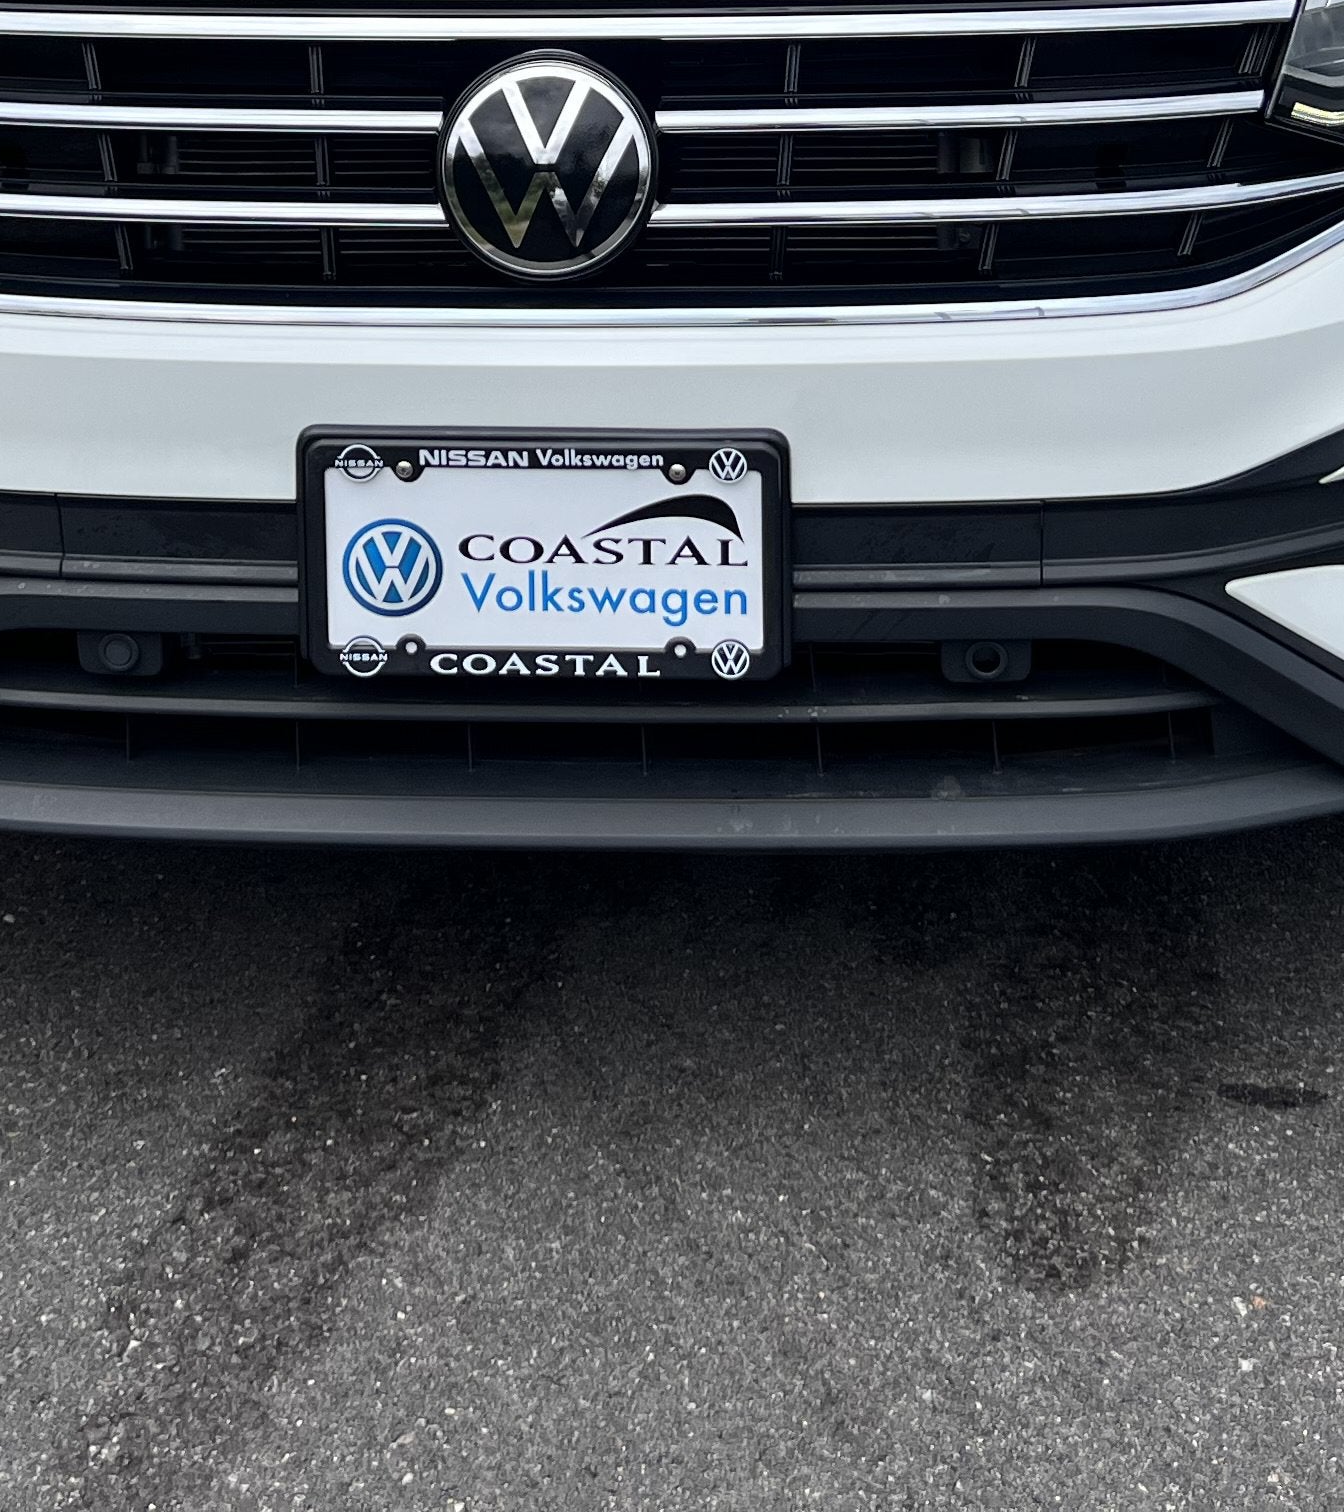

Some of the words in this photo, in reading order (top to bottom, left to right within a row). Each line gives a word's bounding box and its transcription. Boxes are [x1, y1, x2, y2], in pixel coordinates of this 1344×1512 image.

[335, 458, 384, 468] NISSAN
[418, 448, 529, 468] NISSAN
[535, 448, 665, 470] Volkswagen
[457, 534, 749, 567] COASTAL
[460, 569, 749, 627] Volkswagen
[339, 651, 389, 663] NISSAN
[429, 652, 662, 678] COASTAL
